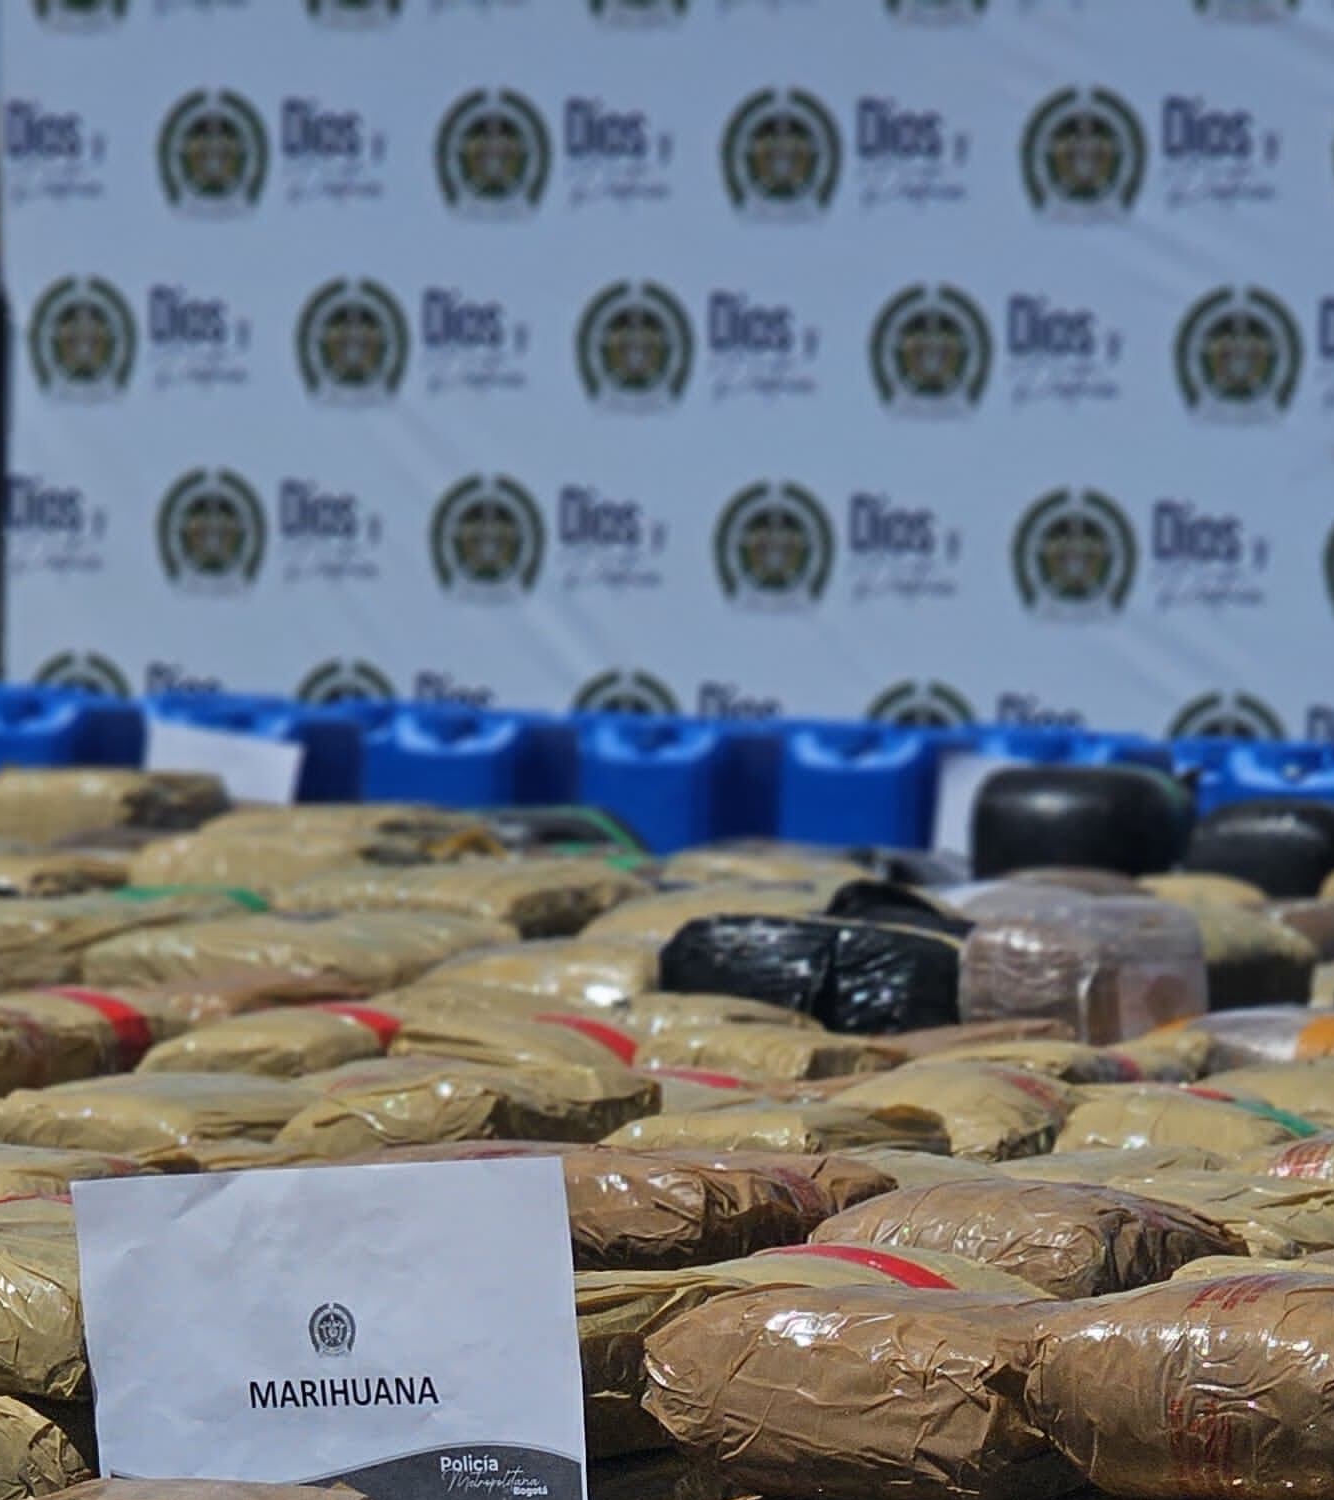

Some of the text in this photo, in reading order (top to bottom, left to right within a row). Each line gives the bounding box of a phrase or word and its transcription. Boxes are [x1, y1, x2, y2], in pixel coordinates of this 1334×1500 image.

[6, 100, 82, 157] Dios
[281, 98, 361, 159] Dios
[565, 98, 647, 159] Dios
[856, 97, 943, 159] Dios
[1163, 96, 1252, 160] Dios
[149, 285, 227, 344] Dios
[422, 288, 503, 348] Dios
[708, 291, 793, 354] Dios
[1007, 294, 1095, 357] Dios
[7, 476, 83, 533] Dios
[279, 479, 358, 540] Dios
[559, 485, 640, 548] Dios
[849, 493, 935, 555] Dios
[1152, 500, 1241, 565] Dios
[249, 1376, 440, 1409] MARIHUANA
[440, 1454, 499, 1473] Policía
[441, 1465, 540, 1494] Metropolitana
[513, 1485, 548, 1497] Bogotá
